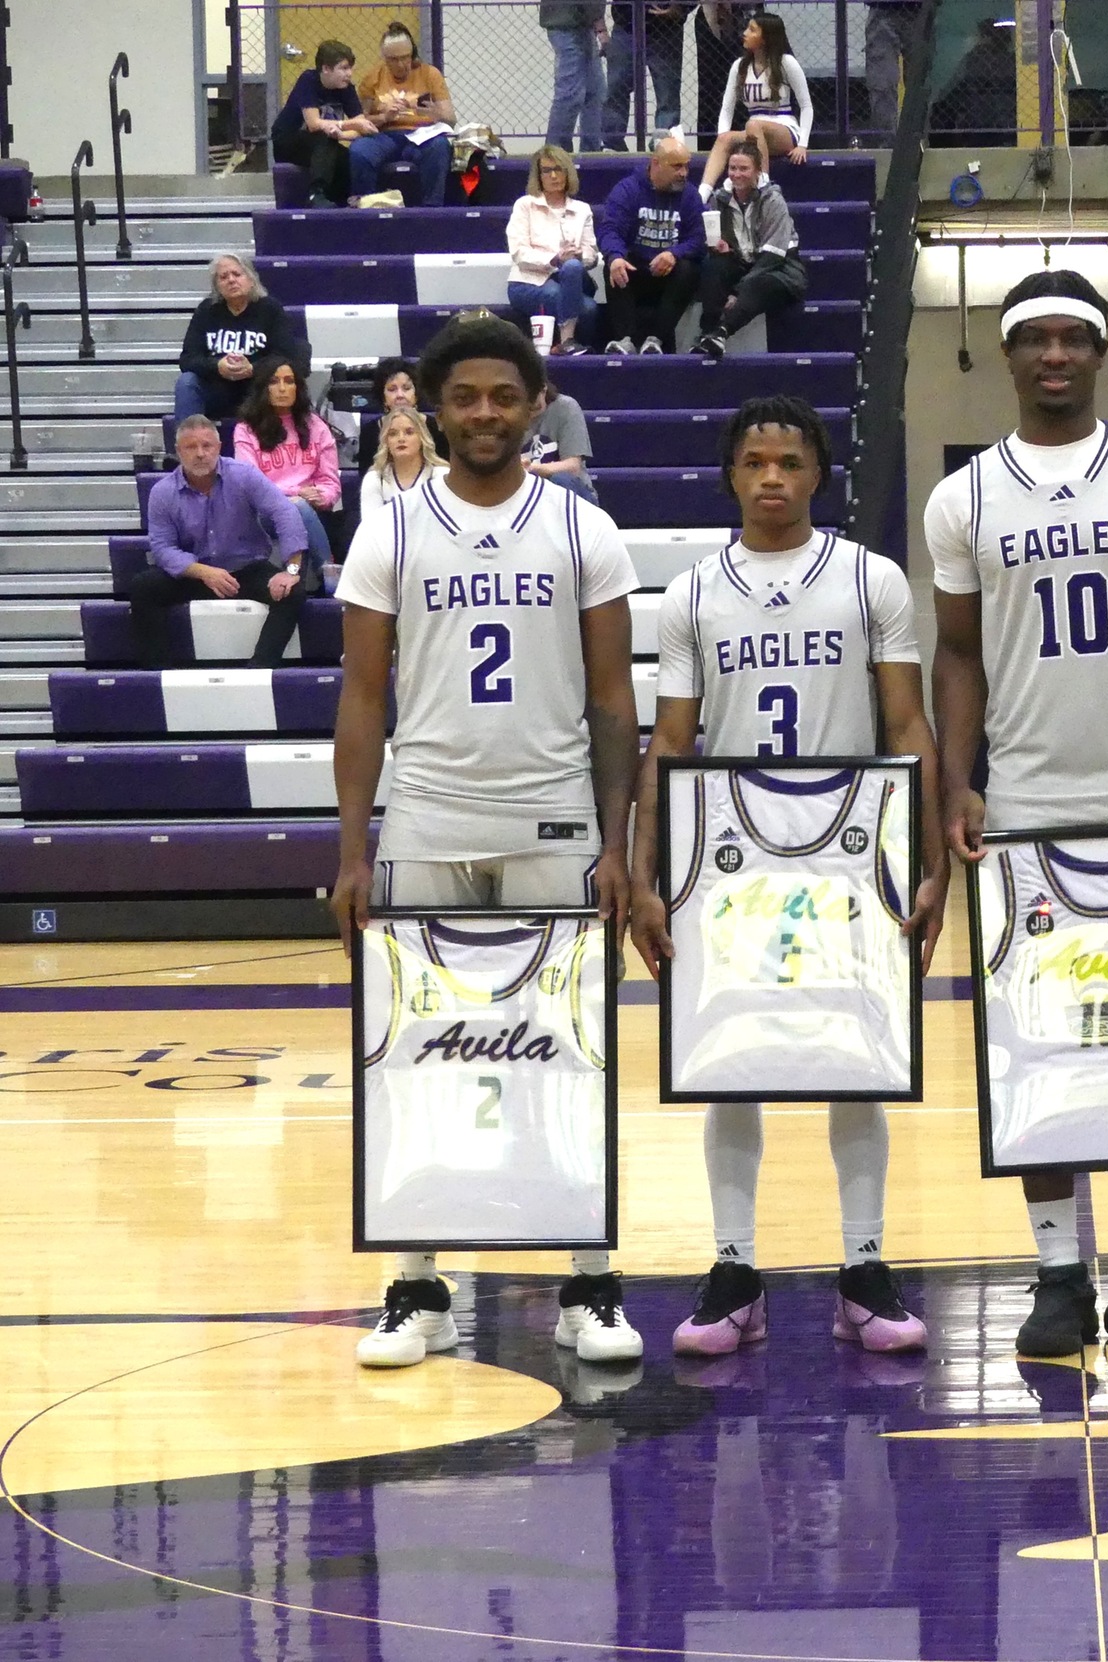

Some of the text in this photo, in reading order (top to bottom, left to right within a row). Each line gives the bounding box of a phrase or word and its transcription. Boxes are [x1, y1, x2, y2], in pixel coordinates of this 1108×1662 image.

[638, 206, 681, 221] AVILA
[206, 329, 267, 356] EAGLES
[256, 442, 320, 472] LOVE
[423, 572, 555, 612] EAGLES
[470, 622, 513, 704] 2
[716, 630, 843, 675] EAGLES
[757, 684, 798, 757] 3
[846, 830, 865, 846] DC
[720, 849, 739, 864] JB
[1031, 914, 1050, 930] JB
[0, 1042, 286, 1064] ris
[414, 1020, 559, 1064] Avila
[475, 1076, 502, 1129] 2
